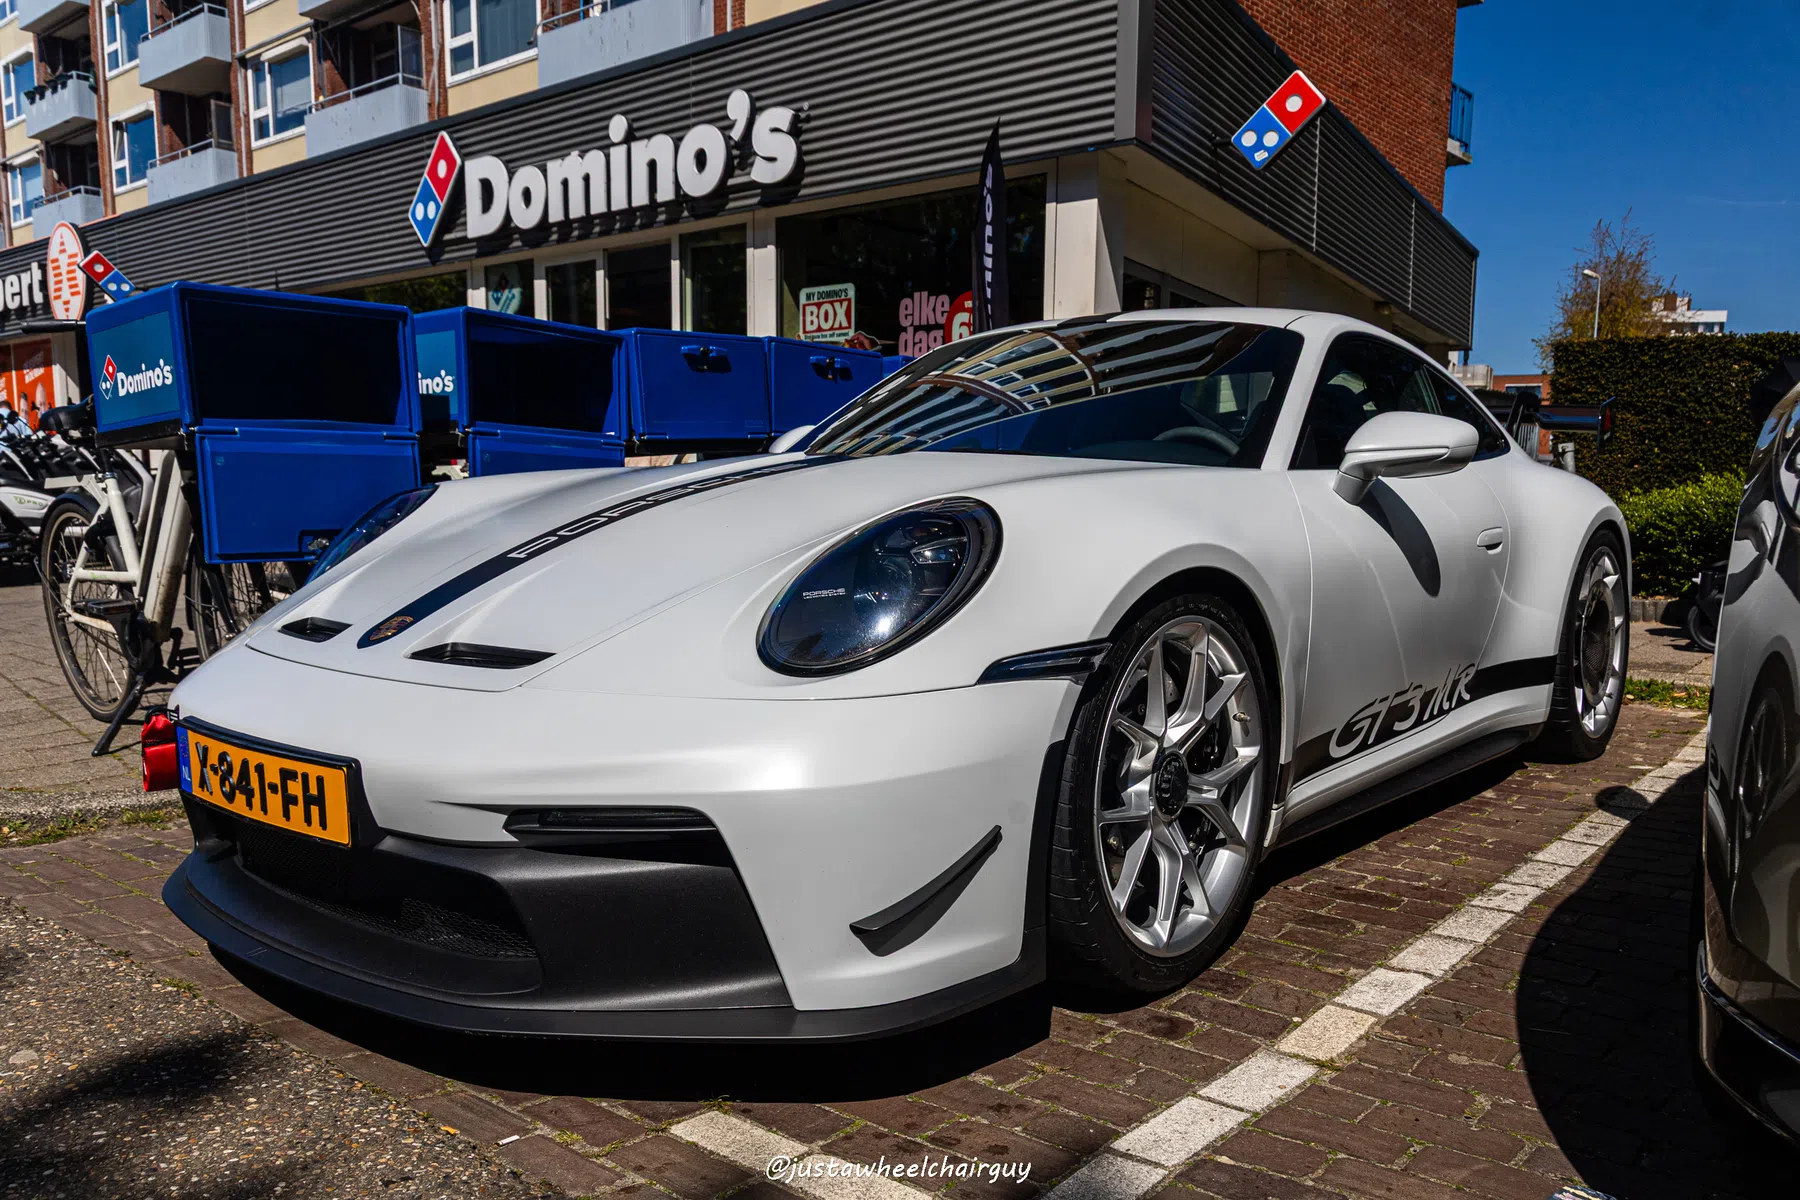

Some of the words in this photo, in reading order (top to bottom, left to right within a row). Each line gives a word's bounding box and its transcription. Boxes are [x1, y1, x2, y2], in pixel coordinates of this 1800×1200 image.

[465, 88, 797, 239] Domino's
[805, 292, 816, 302] MY
[817, 288, 849, 300] DOMINO'S
[899, 291, 950, 327] elke
[805, 301, 849, 331] BOX
[116, 358, 173, 397] Domino's
[507, 463, 807, 558] PORSCHE
[803, 587, 846, 596] PORSCHE
[182, 765, 192, 782] NL
[195, 741, 328, 831] X-841-FH
